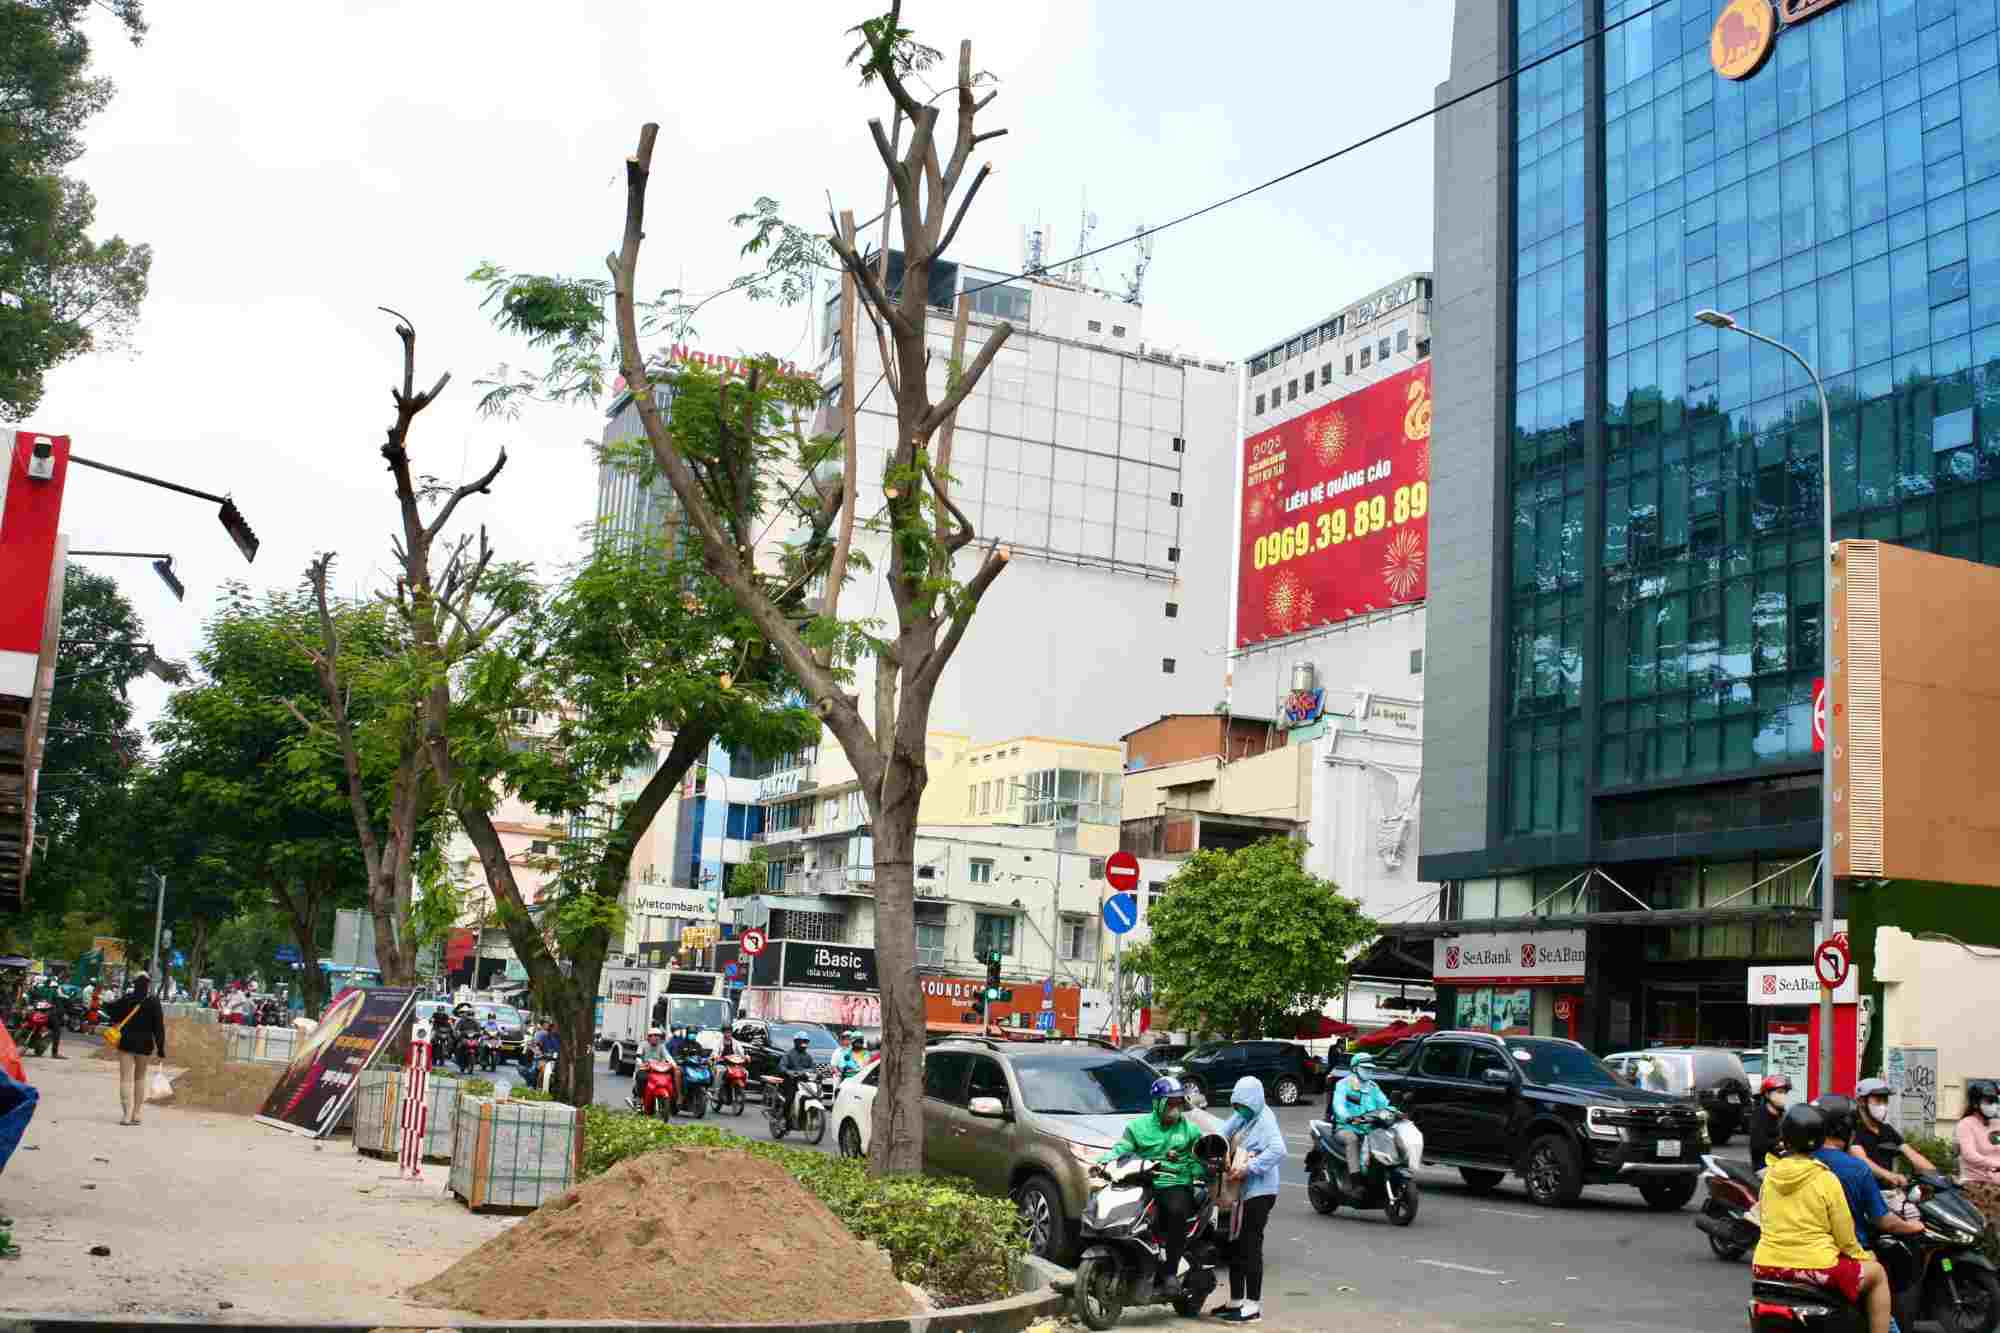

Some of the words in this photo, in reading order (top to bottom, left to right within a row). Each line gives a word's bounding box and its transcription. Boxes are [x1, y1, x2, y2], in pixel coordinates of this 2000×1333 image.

[1367, 458, 1392, 483] CÁO
[1253, 480, 1428, 570] 0969.39.89.89
[637, 895, 704, 913] Vietcombank
[815, 948, 862, 969] iBasic
[1462, 948, 1512, 966] SeABank
[1538, 946, 1585, 963] SeABan
[1779, 977, 1819, 991] SeABa
